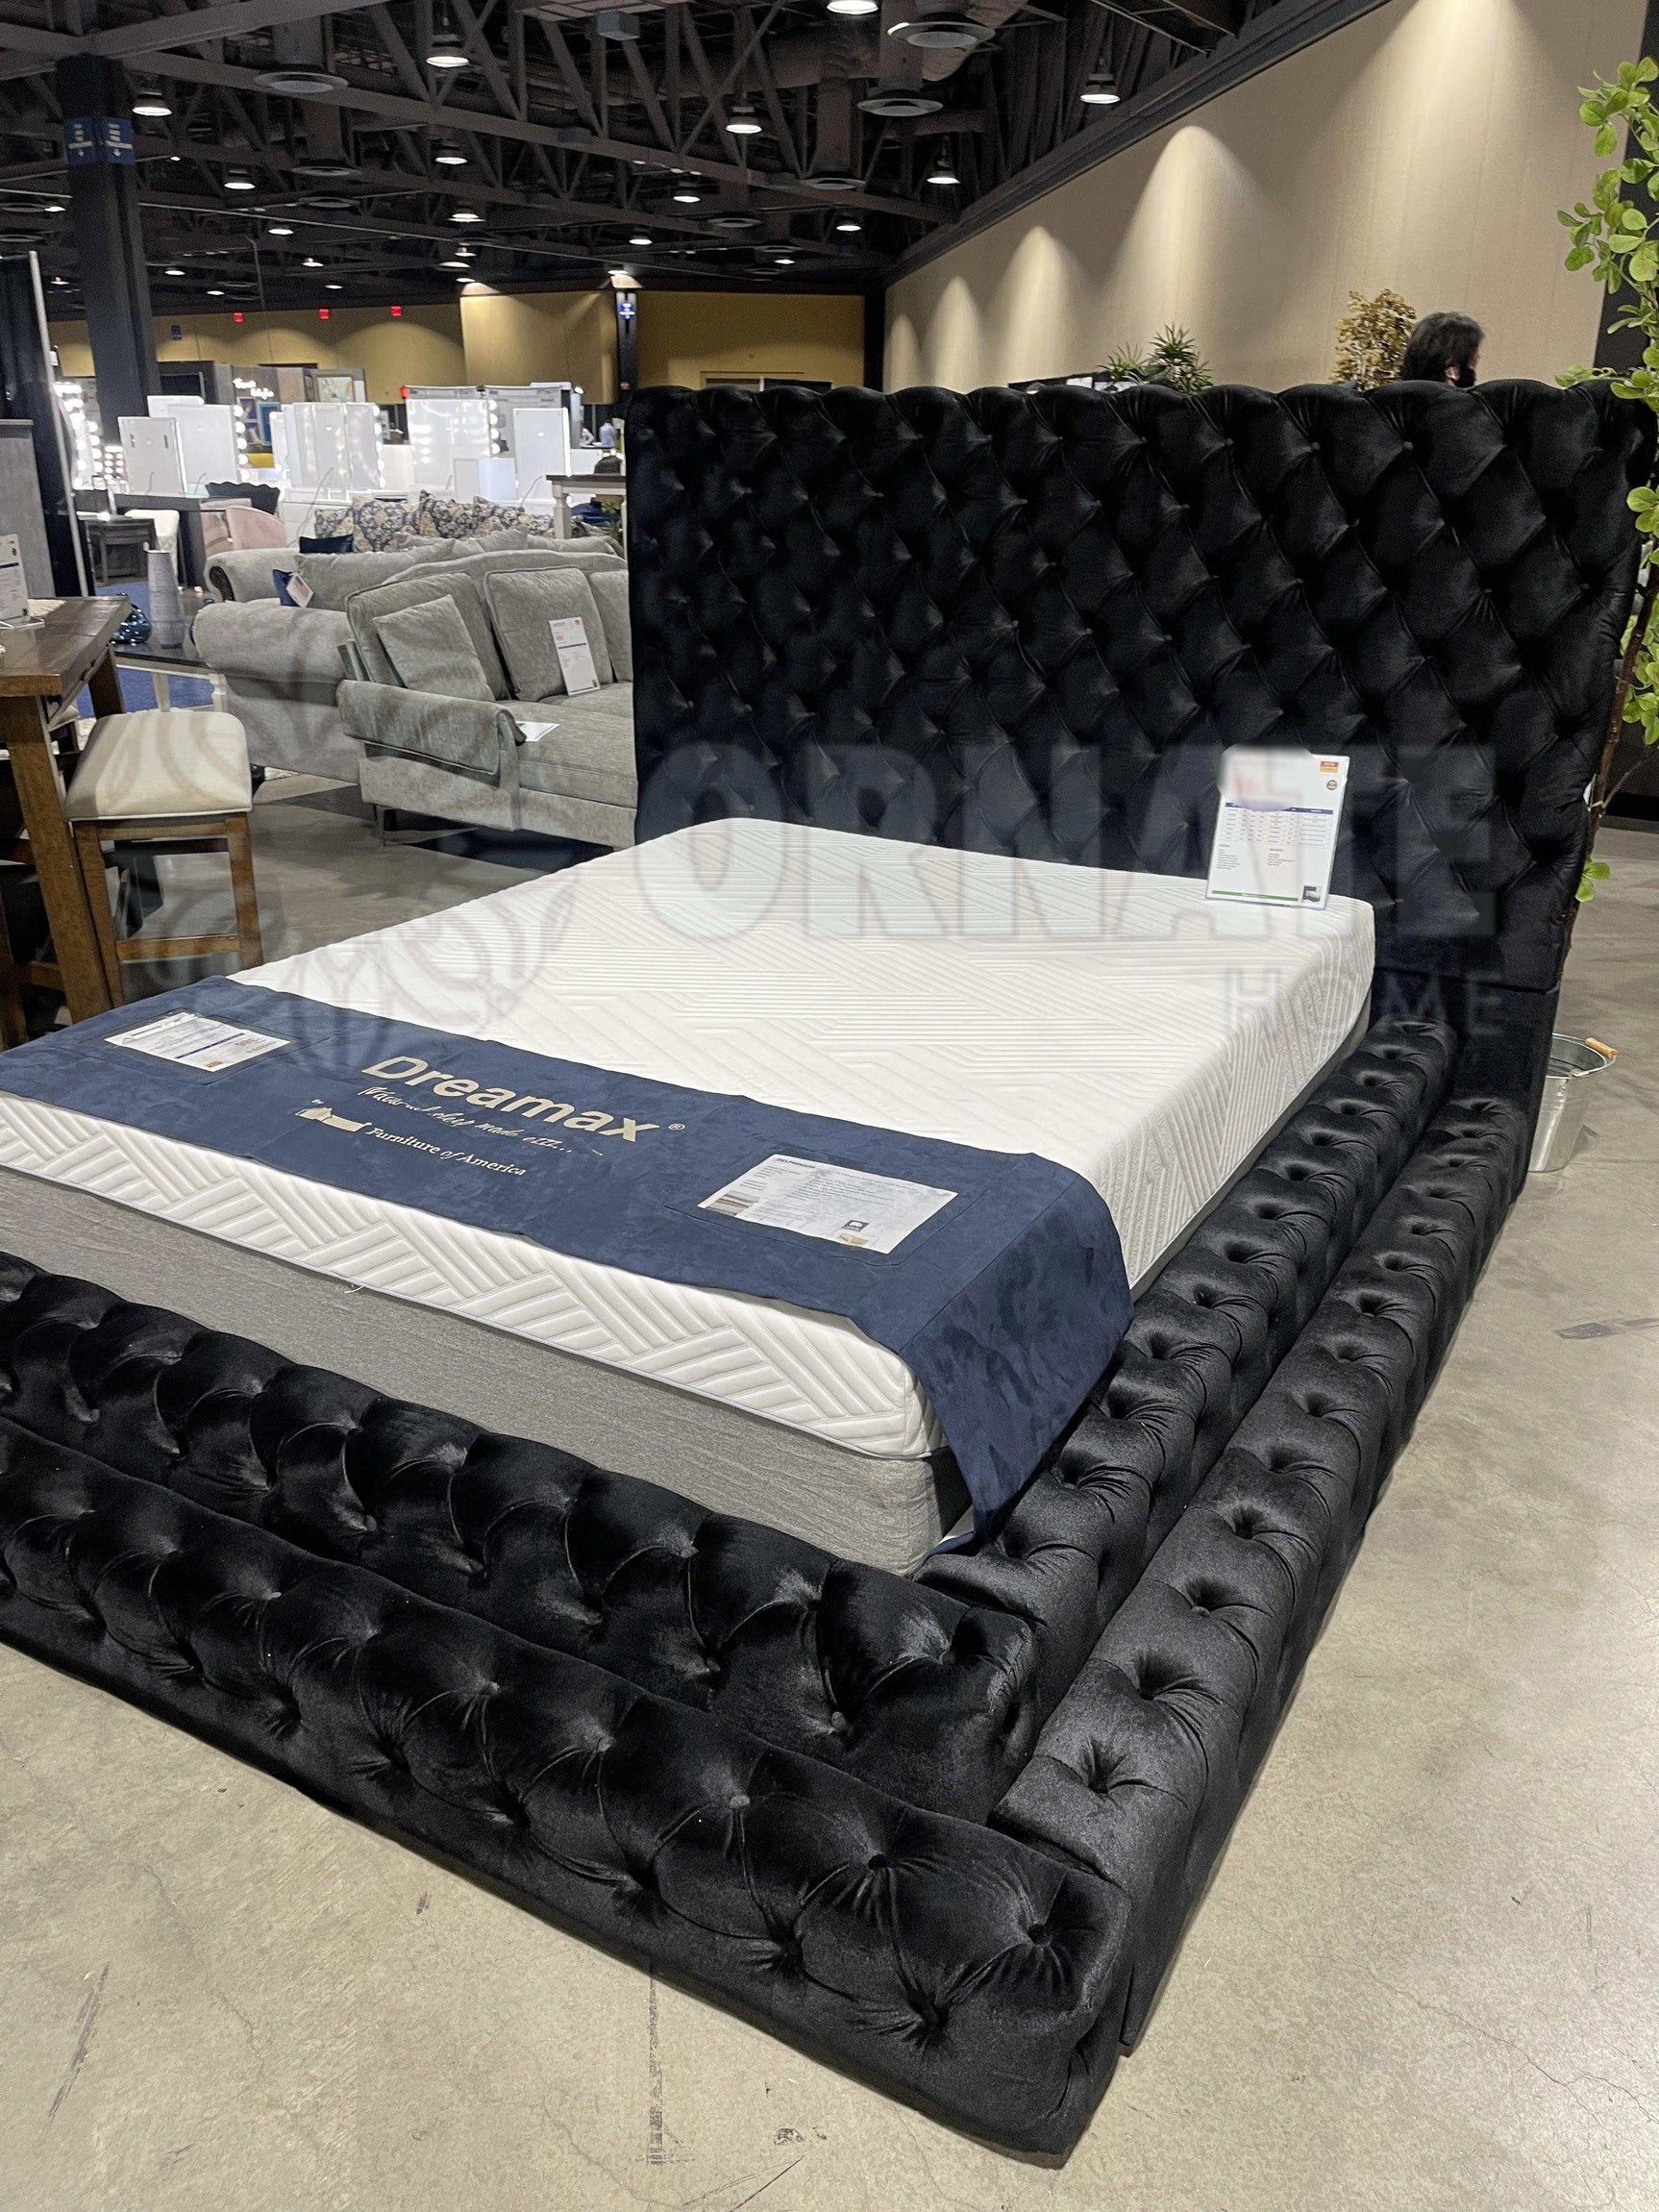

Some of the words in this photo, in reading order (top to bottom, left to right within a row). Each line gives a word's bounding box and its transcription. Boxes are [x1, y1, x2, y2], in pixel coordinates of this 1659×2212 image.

[361, 1056, 660, 1143] Dreamax
[365, 1127, 440, 1155] Furniture
[457, 1154, 527, 1176] America
